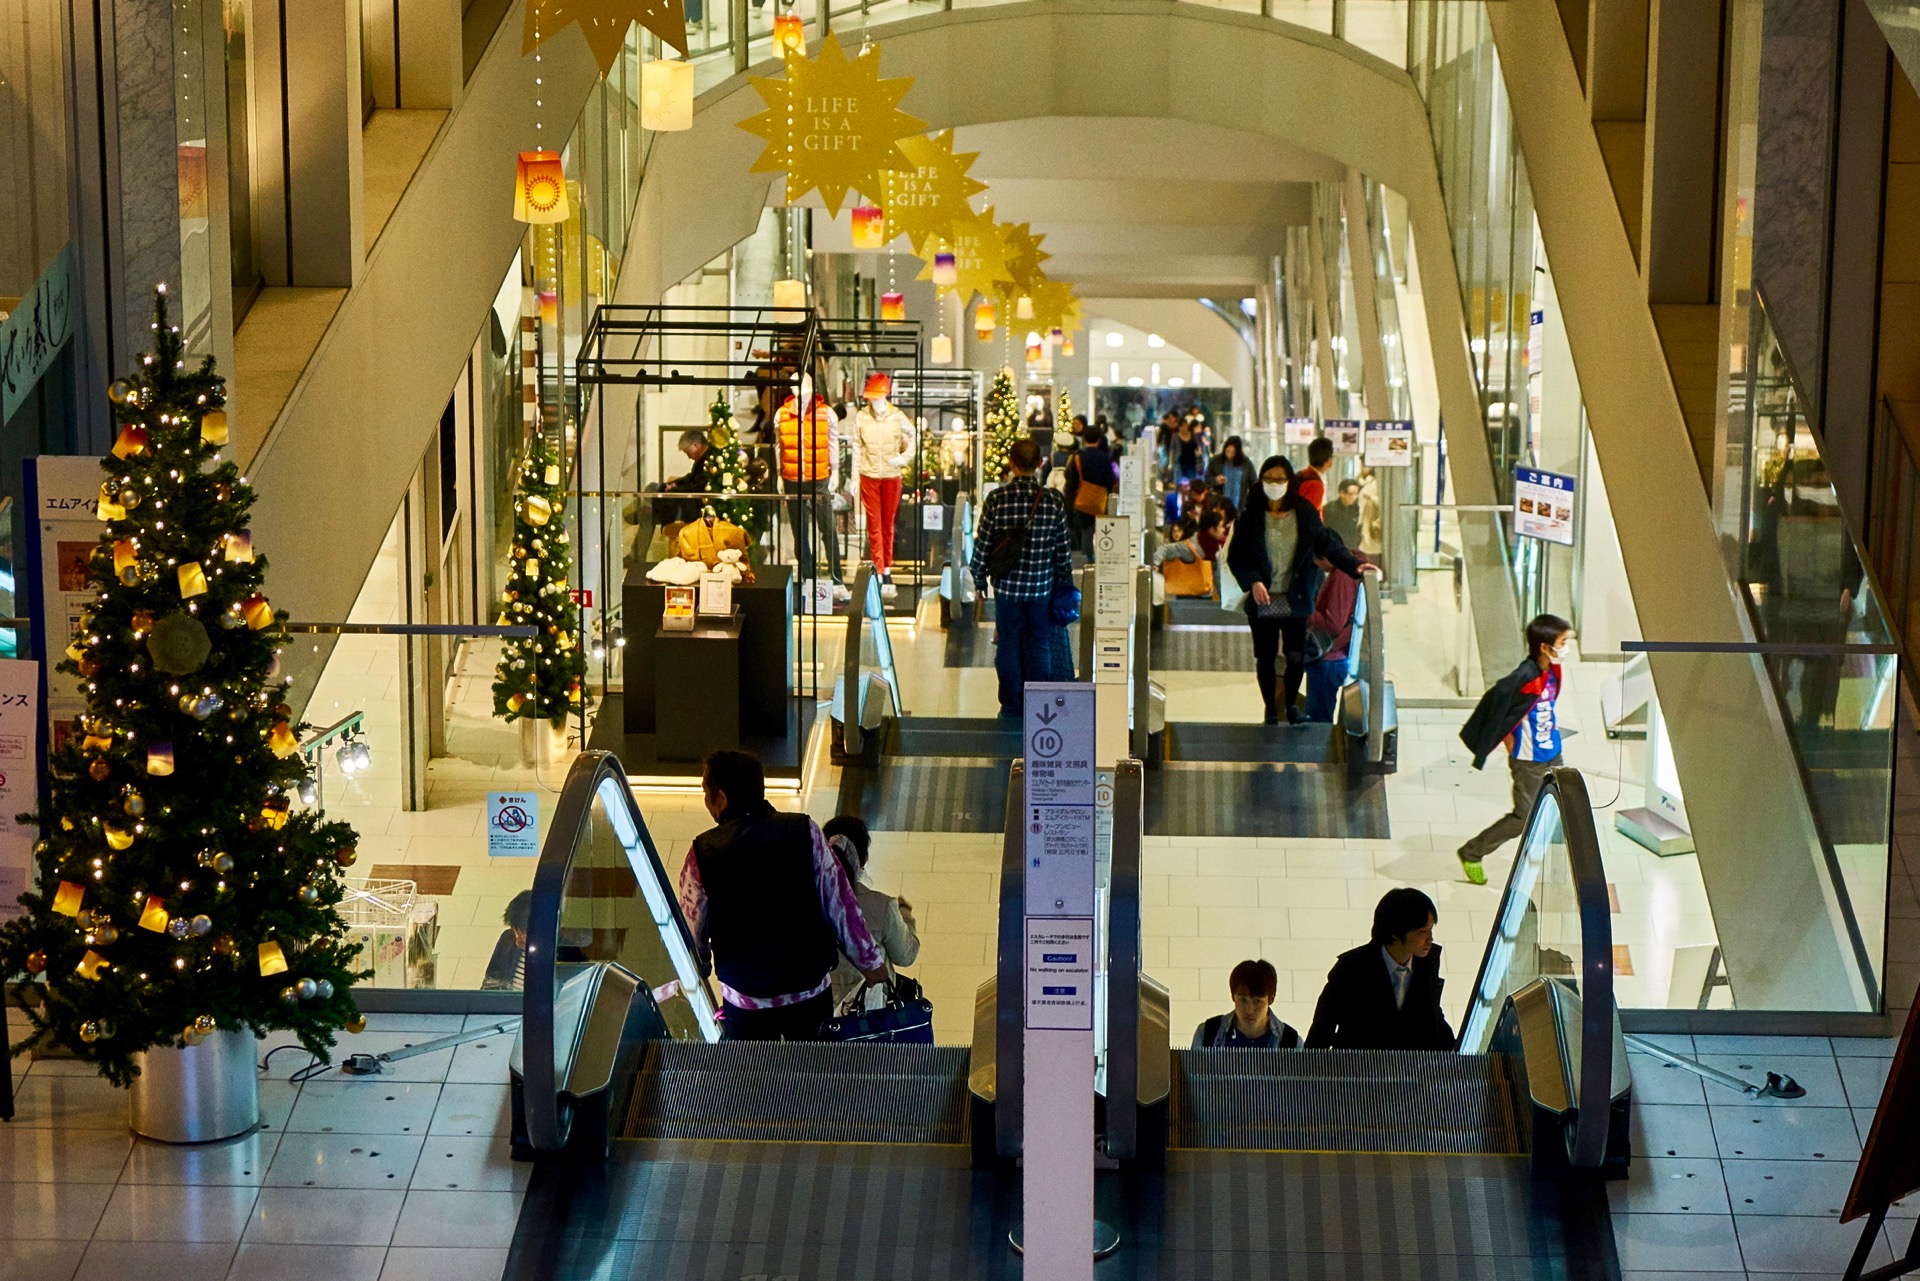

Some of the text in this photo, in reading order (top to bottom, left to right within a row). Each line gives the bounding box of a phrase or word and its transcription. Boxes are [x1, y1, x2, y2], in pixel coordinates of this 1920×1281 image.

[807, 97, 859, 113] LIFE
[814, 117, 851, 130] IS A
[804, 134, 862, 151] GIFT
[904, 180, 932, 191] IS A
[896, 193, 941, 207] GIFT
[1528, 472, 1564, 489] ご案内
[1040, 736, 1055, 750] 10
